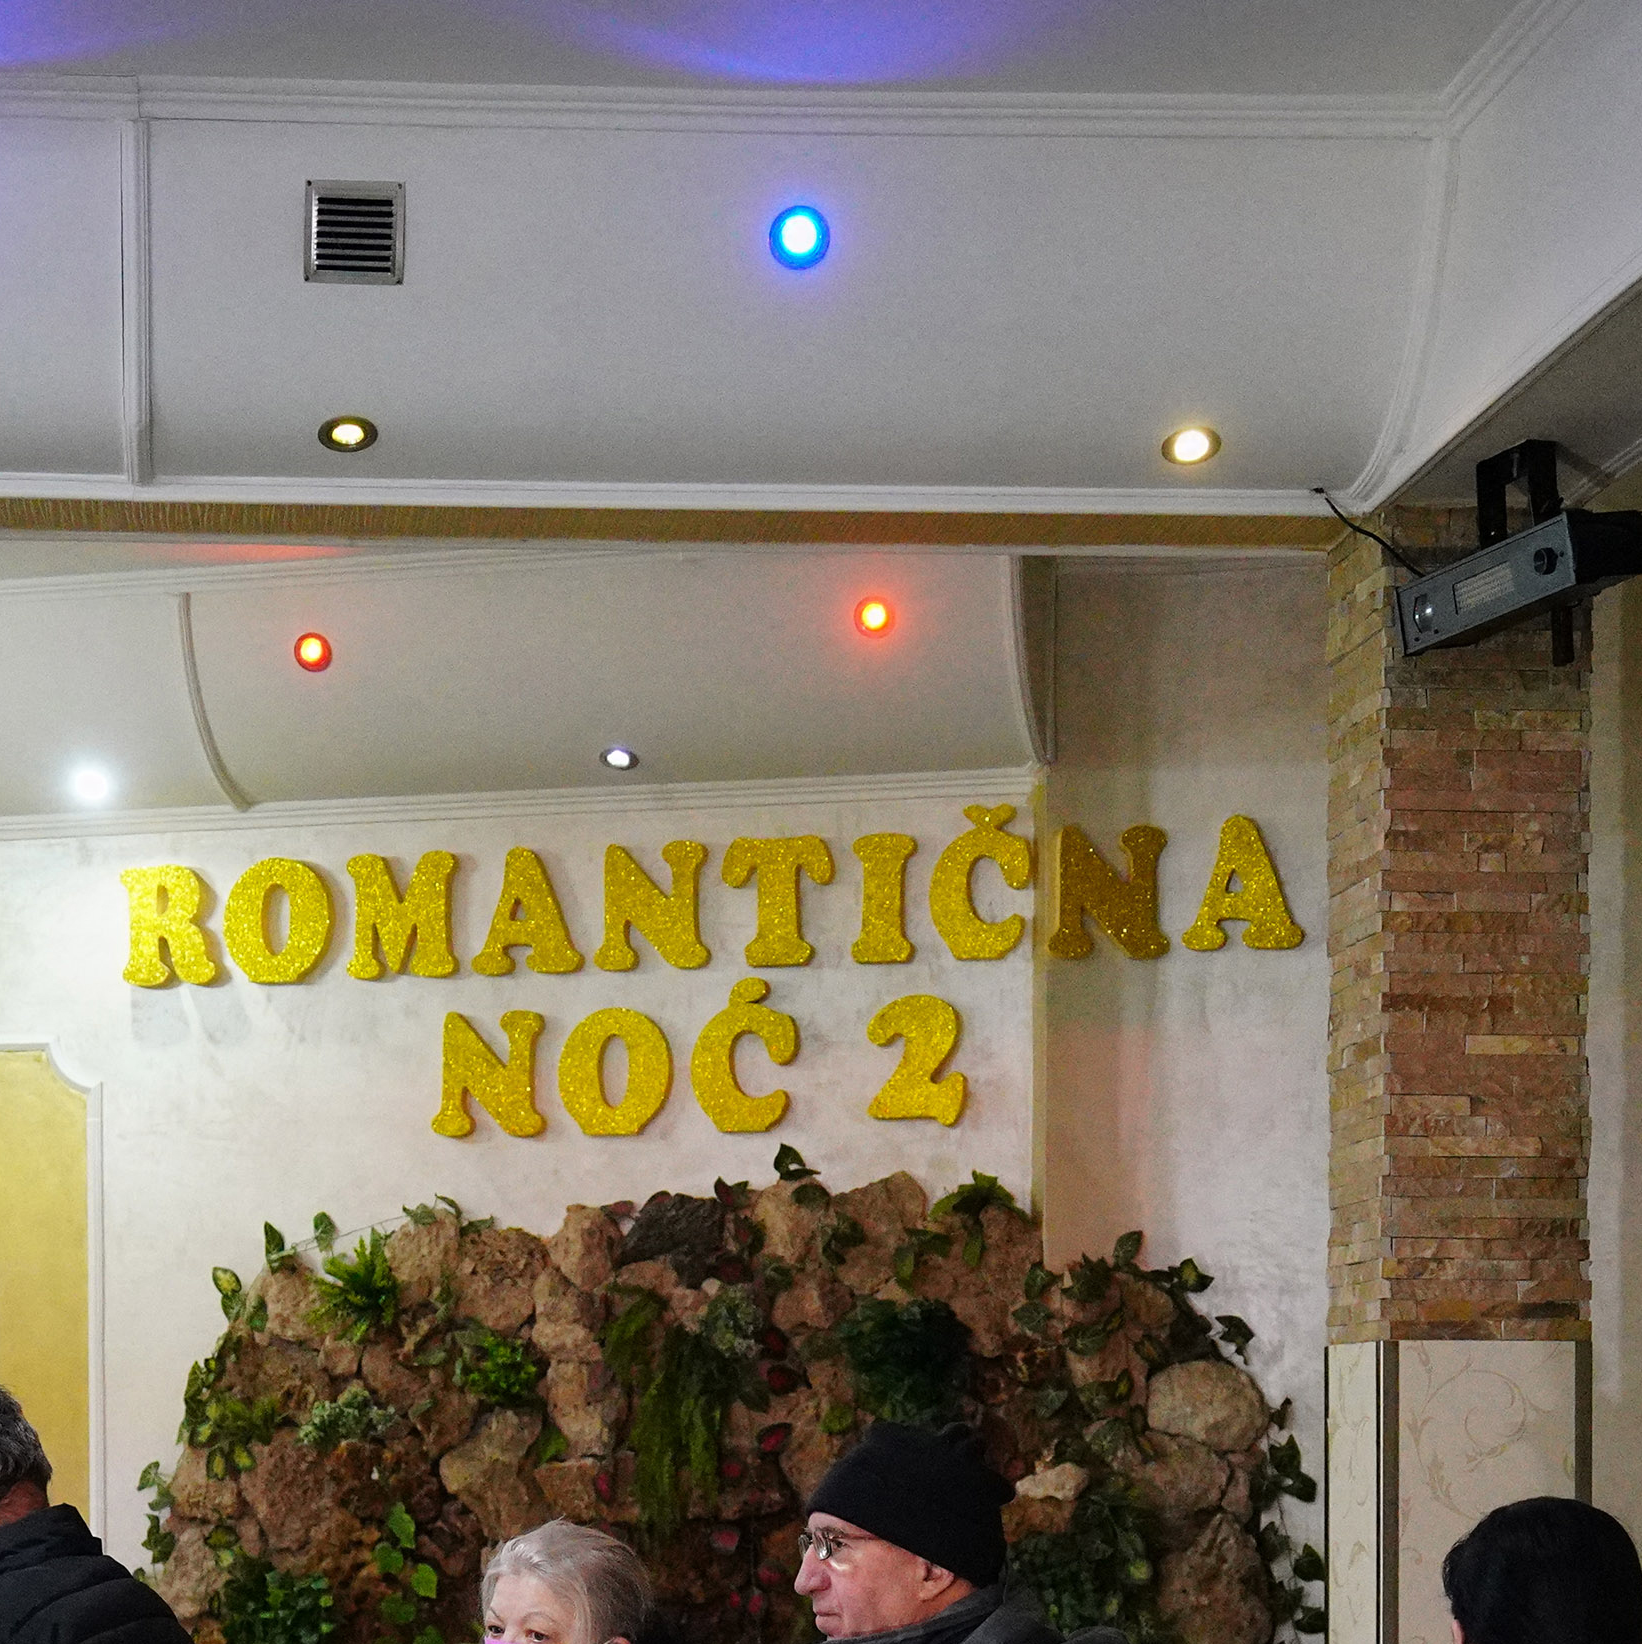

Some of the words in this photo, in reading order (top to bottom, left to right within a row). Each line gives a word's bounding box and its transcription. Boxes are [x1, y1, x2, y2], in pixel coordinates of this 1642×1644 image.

[118, 803, 1304, 988] ROMANTIČNA
[430, 977, 800, 1140] NOĆ
[867, 993, 967, 1128] 2
